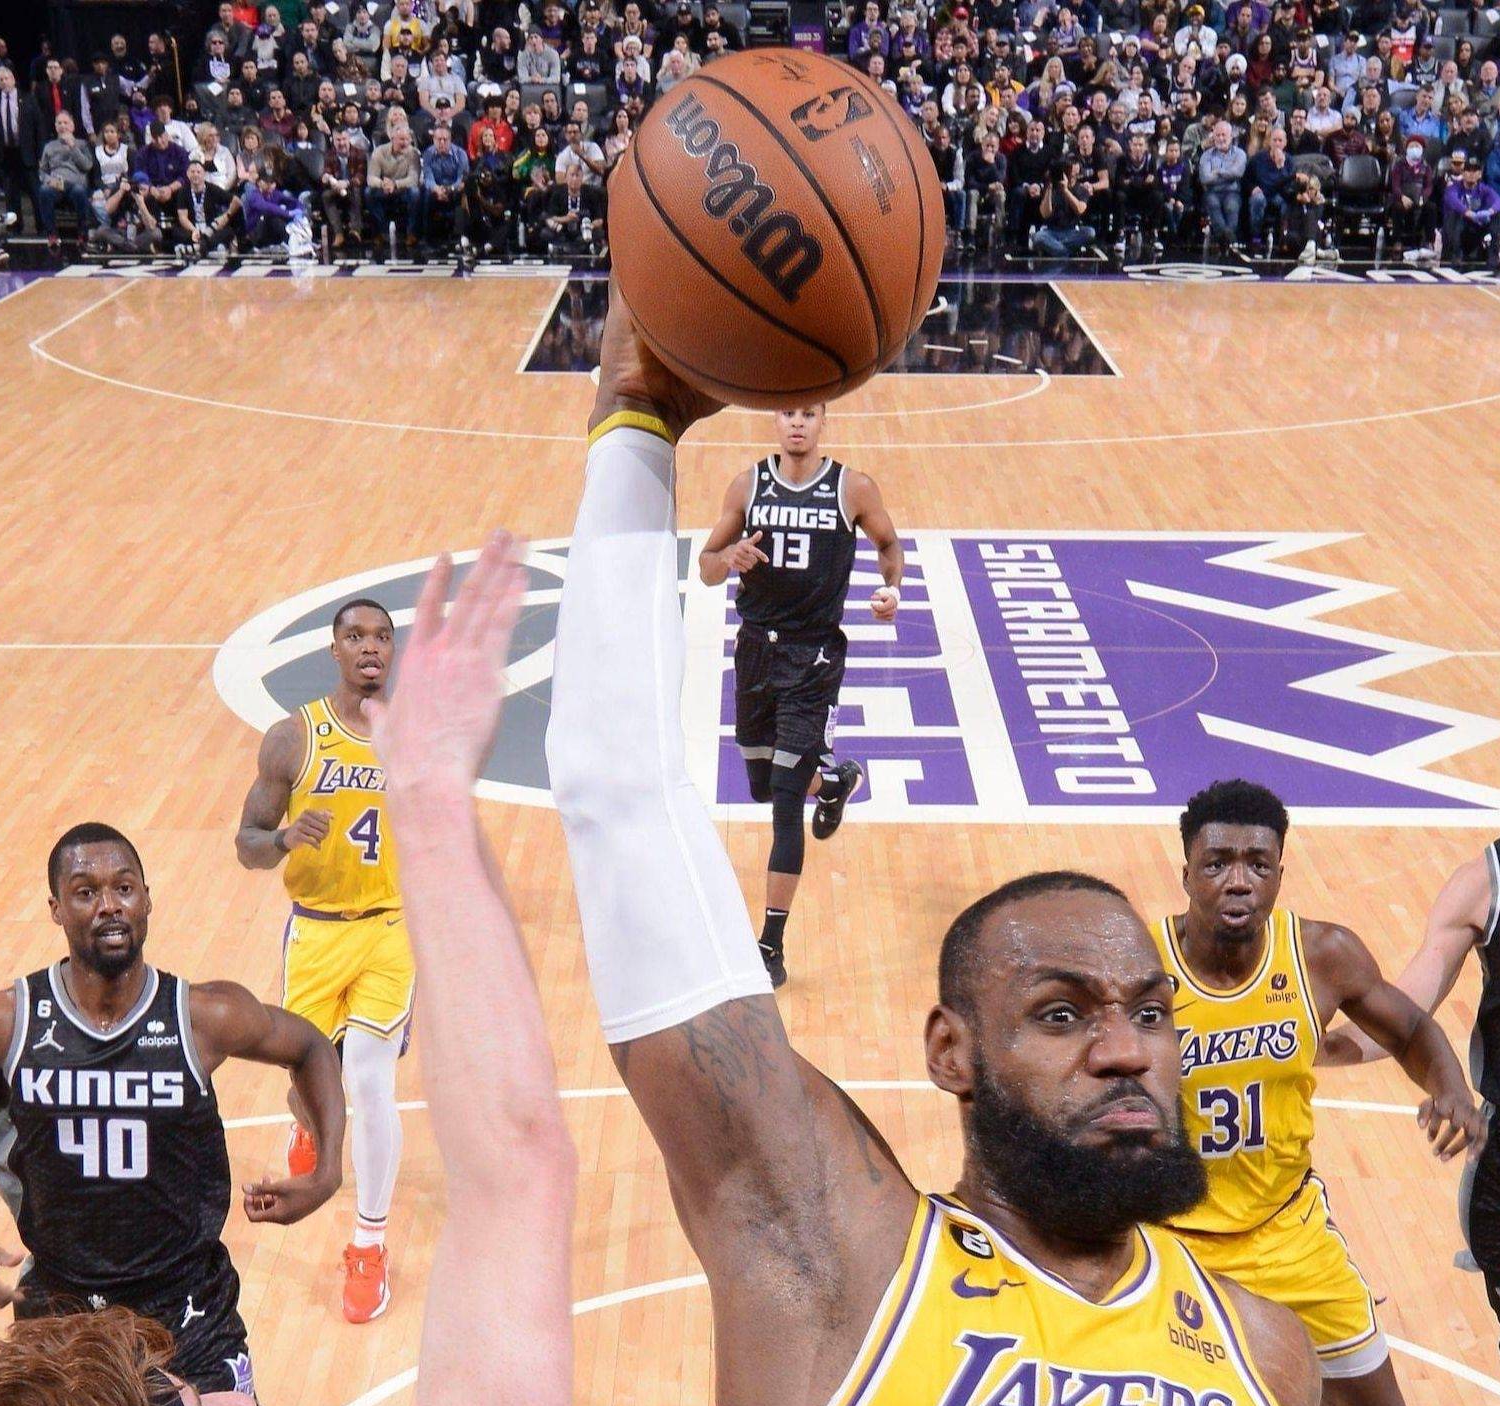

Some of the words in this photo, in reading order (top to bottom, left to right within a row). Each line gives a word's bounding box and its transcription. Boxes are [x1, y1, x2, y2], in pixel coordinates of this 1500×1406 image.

[752, 505, 837, 530] KINGS
[772, 532, 810, 570] 13
[979, 543, 1157, 794] SACRAMENTO
[308, 756, 388, 795] LAKE
[345, 806, 381, 866] 4
[37, 999, 51, 1018] 6
[1266, 991, 1298, 1004] bibigo
[138, 1033, 179, 1047] dialpad
[21, 1068, 184, 1108] KINGS
[1197, 1080, 1267, 1160] 31
[57, 1118, 148, 1179] 40
[1168, 1322, 1226, 1364] bibigo
